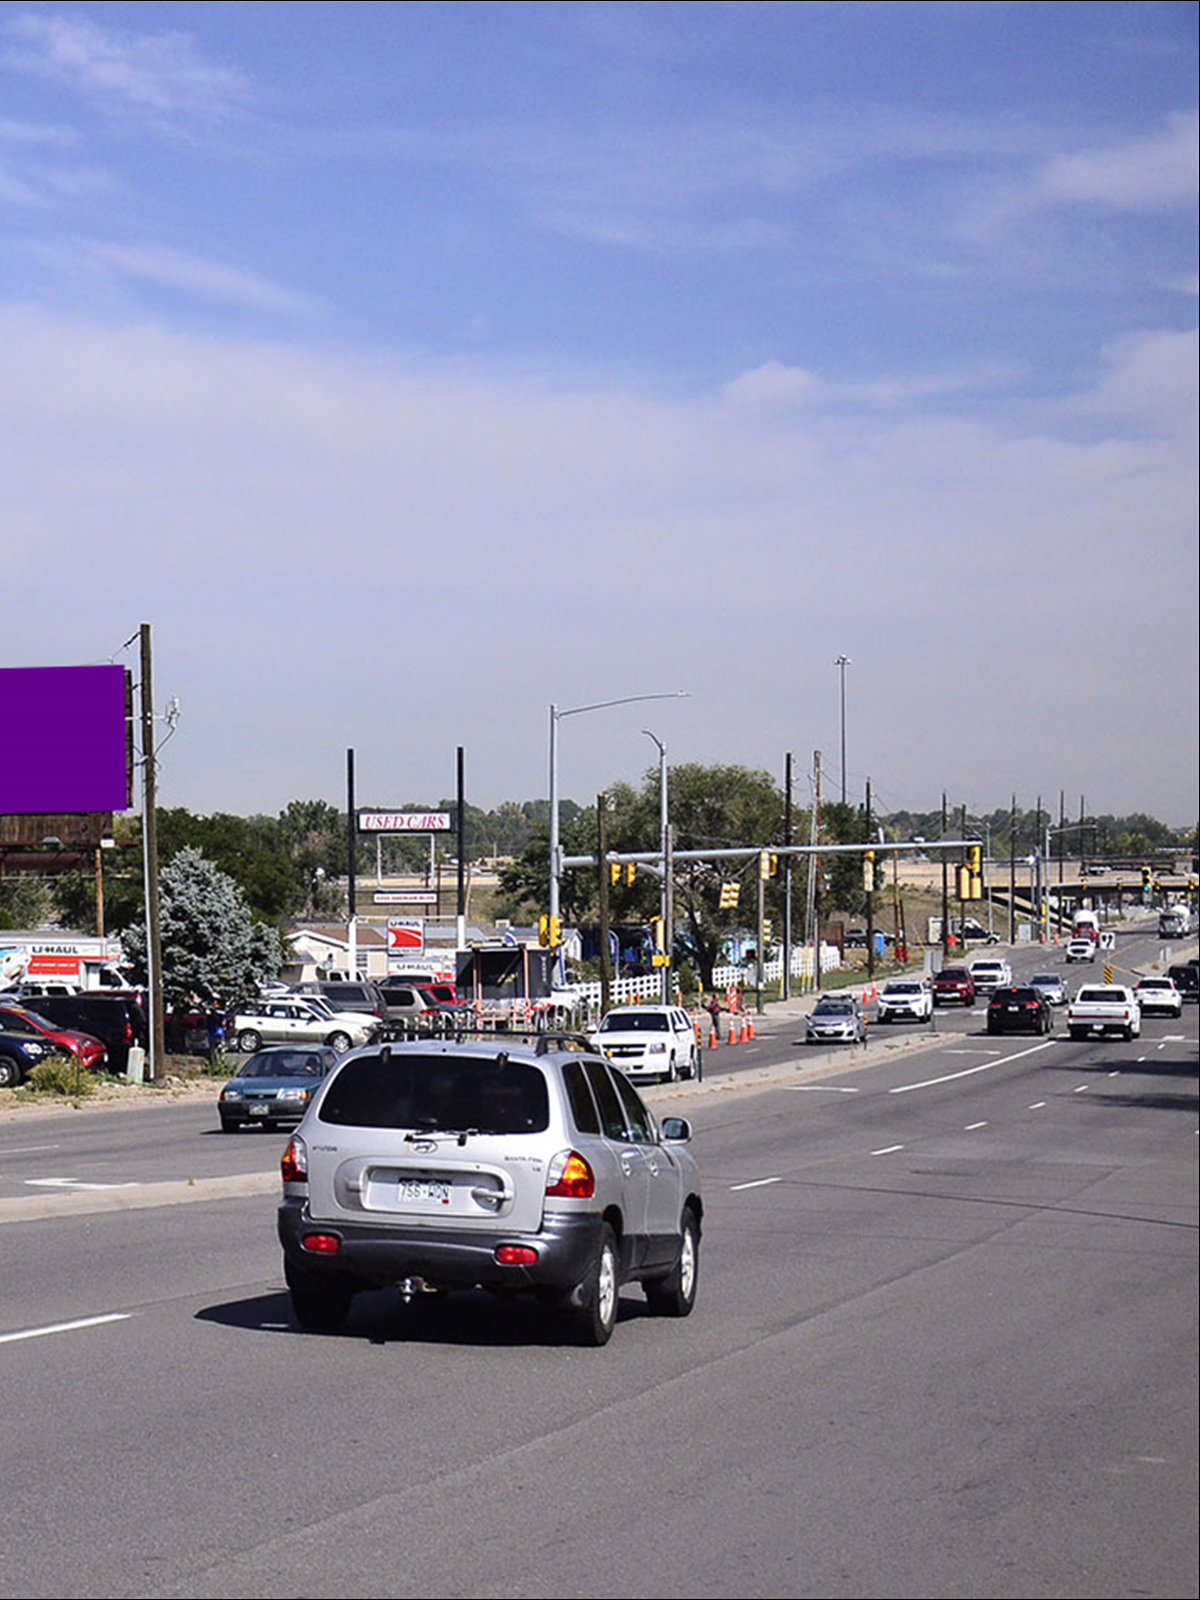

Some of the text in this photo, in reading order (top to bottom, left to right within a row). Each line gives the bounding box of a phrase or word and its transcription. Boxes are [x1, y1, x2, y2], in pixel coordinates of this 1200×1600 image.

[365, 815, 446, 829] USED CARS
[31, 945, 79, 954] U-HAUL
[396, 963, 435, 971] U-HAUL
